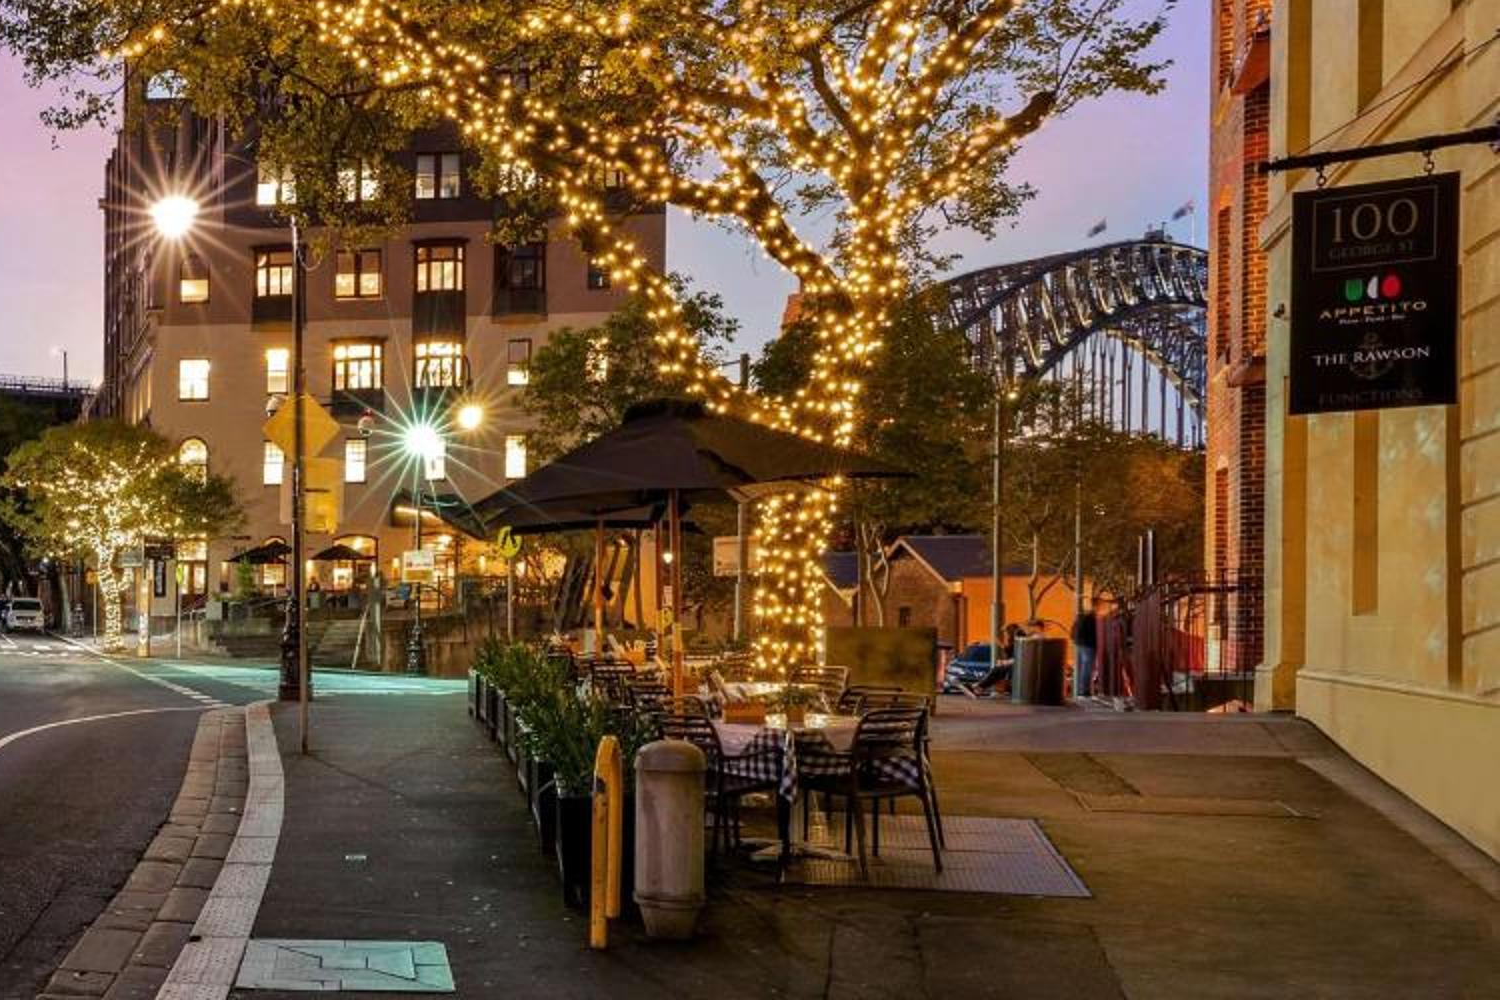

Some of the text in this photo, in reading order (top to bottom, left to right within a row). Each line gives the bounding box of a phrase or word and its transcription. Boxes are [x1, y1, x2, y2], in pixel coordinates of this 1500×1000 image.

[1332, 198, 1419, 243] 100
[1319, 301, 1428, 320] APPETITO
[1313, 345, 1430, 368] THE RAWSON
